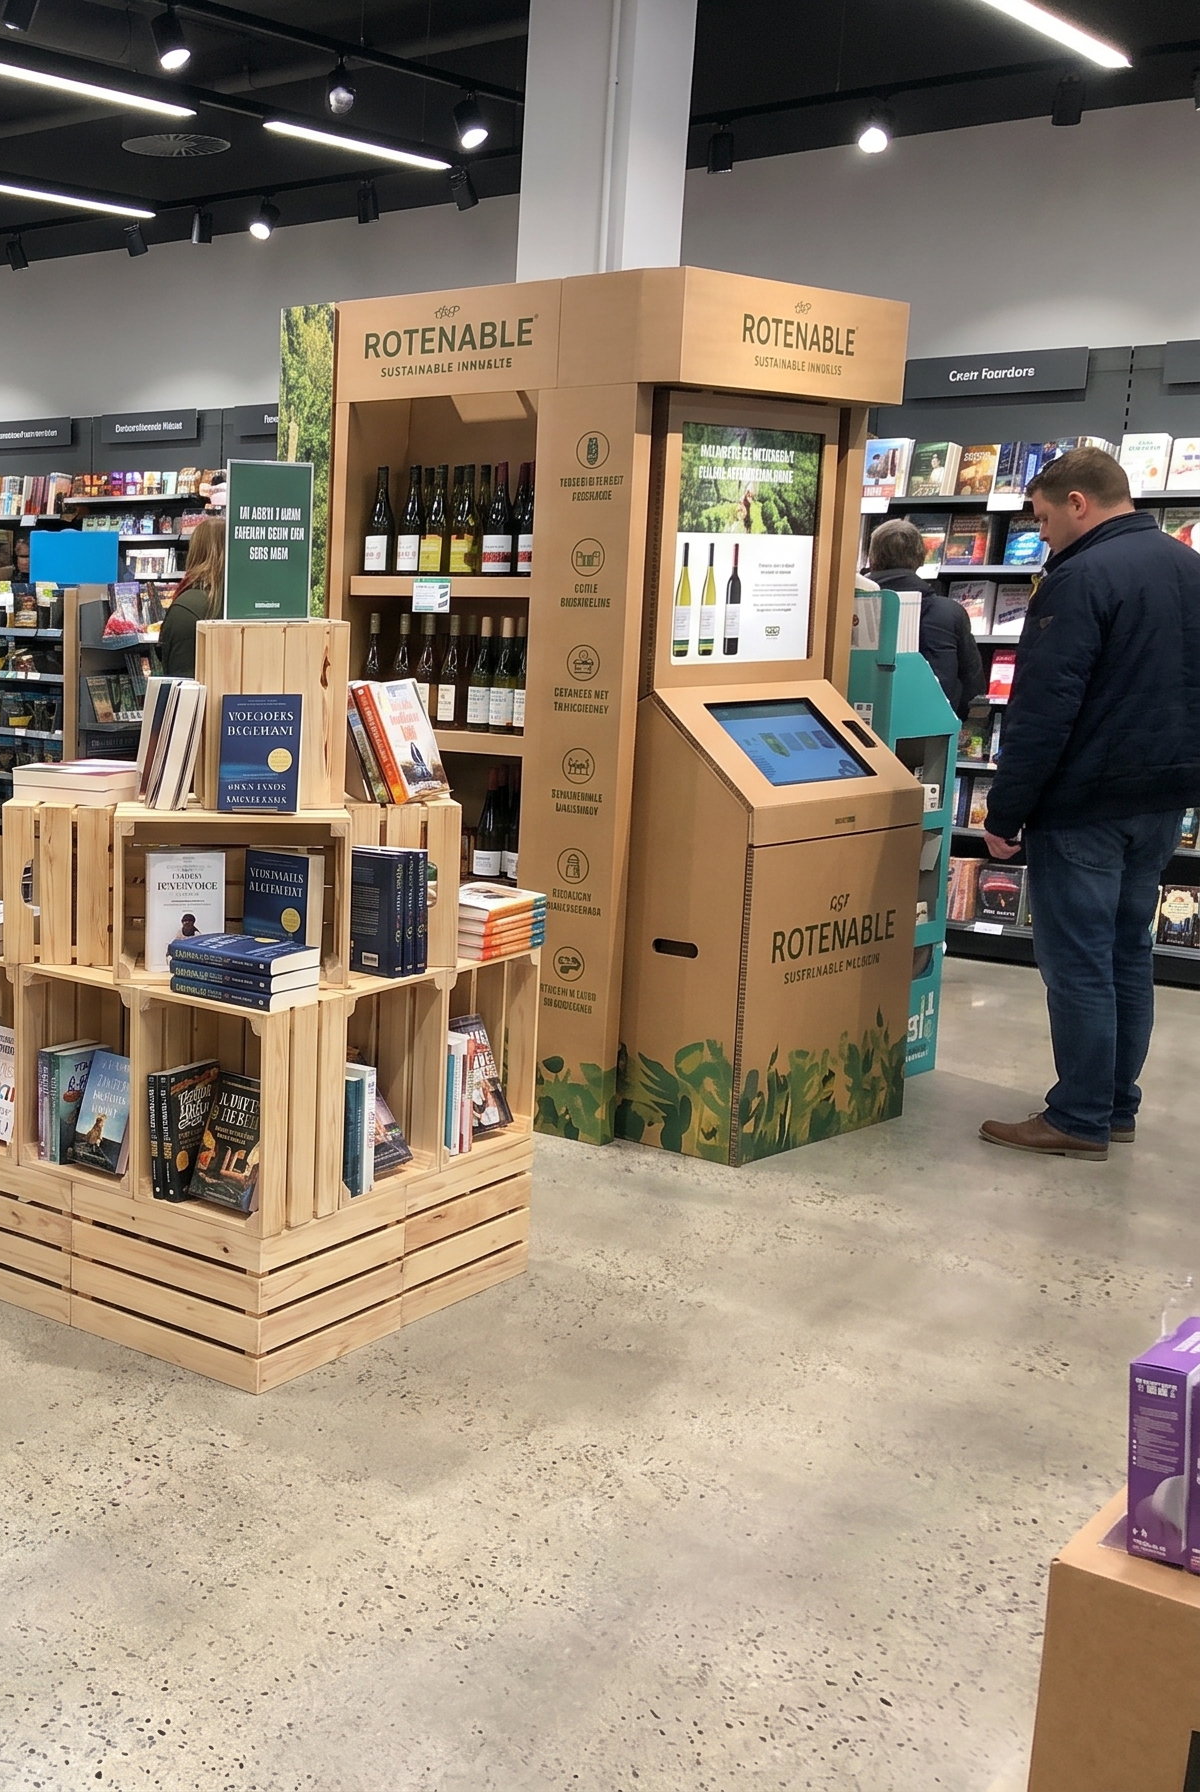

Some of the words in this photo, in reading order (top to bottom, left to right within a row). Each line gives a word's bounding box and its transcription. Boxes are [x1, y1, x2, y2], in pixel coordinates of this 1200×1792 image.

[364, 317, 534, 360] ROTENABLE
[742, 313, 856, 357] ROTENABLE
[380, 362, 453, 378] SUSTAINABLE
[754, 355, 806, 372] SUSTAINABLE
[771, 909, 896, 964] ROTENABLE
